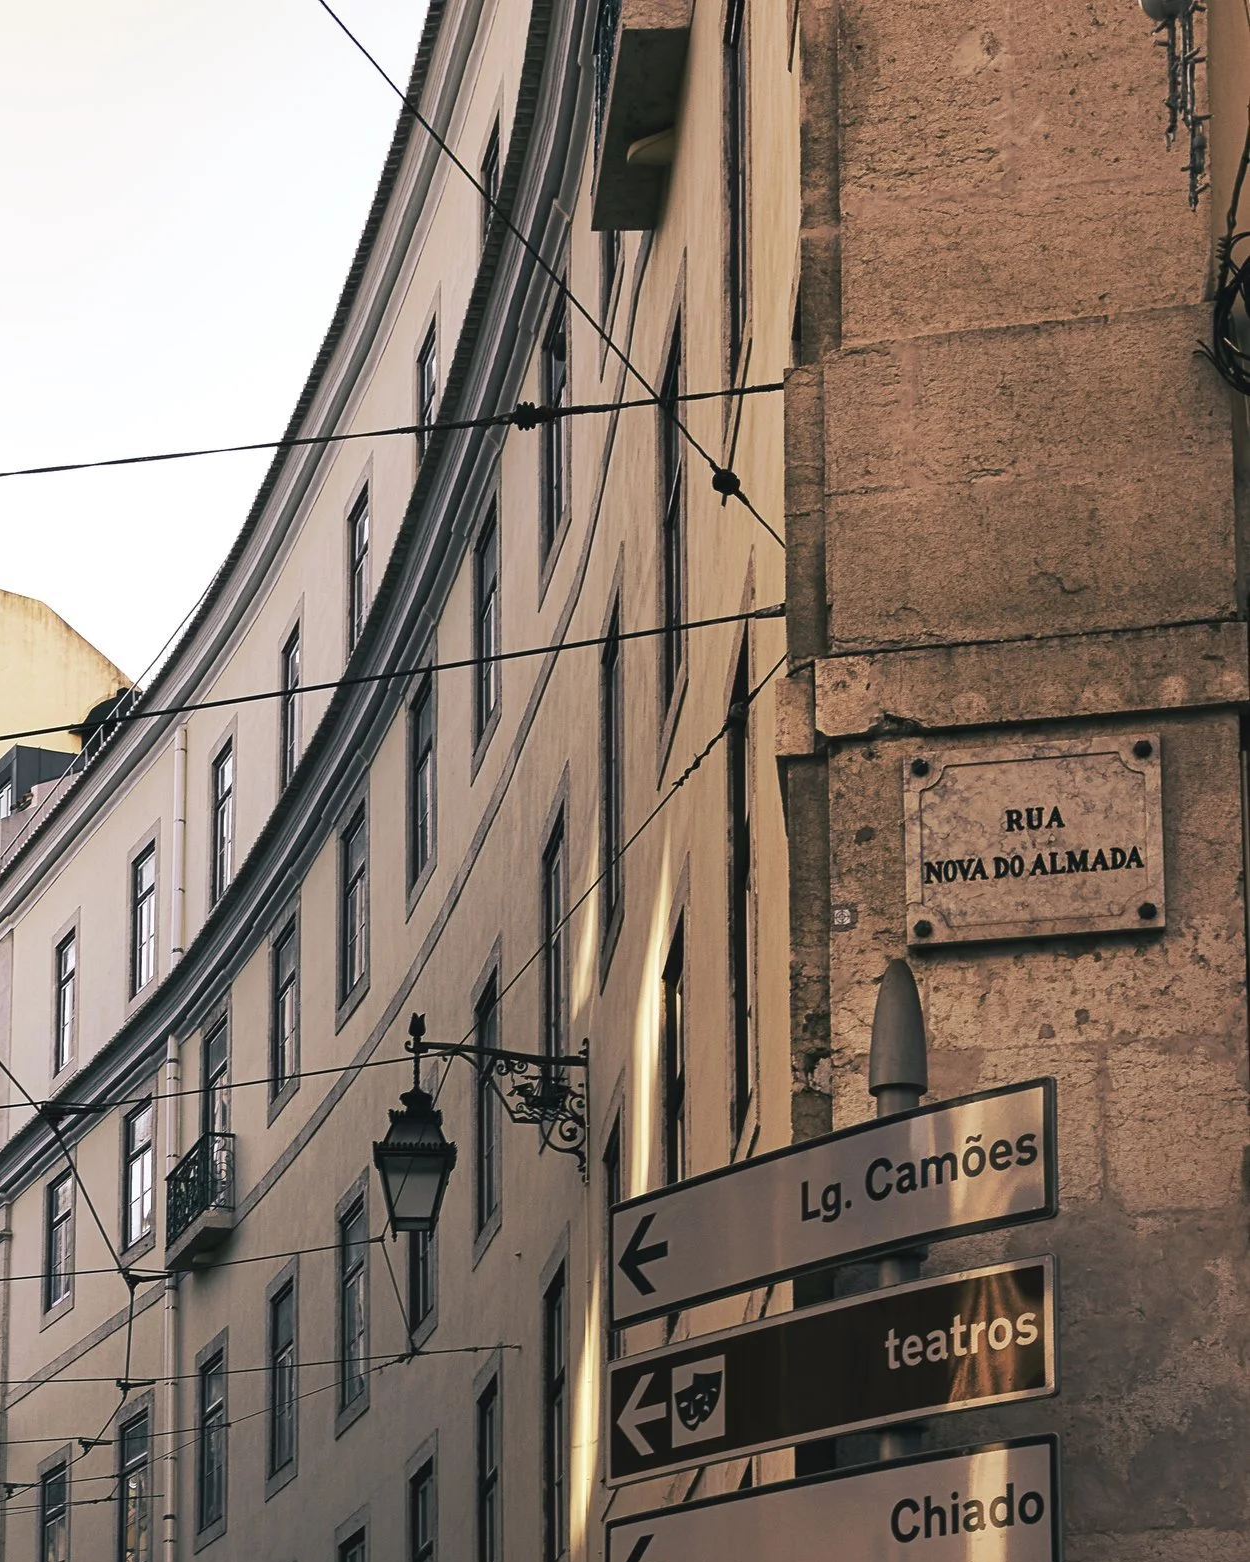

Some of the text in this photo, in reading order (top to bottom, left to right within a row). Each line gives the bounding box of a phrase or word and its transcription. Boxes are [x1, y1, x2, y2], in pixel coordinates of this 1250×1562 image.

[1005, 806, 1065, 832] RUA
[924, 846, 1145, 884] NOVA DO ALMADA
[800, 1132, 1039, 1223] Lg. Camões
[885, 1311, 1039, 1370] teatros
[890, 1483, 1045, 1543] Chiado
